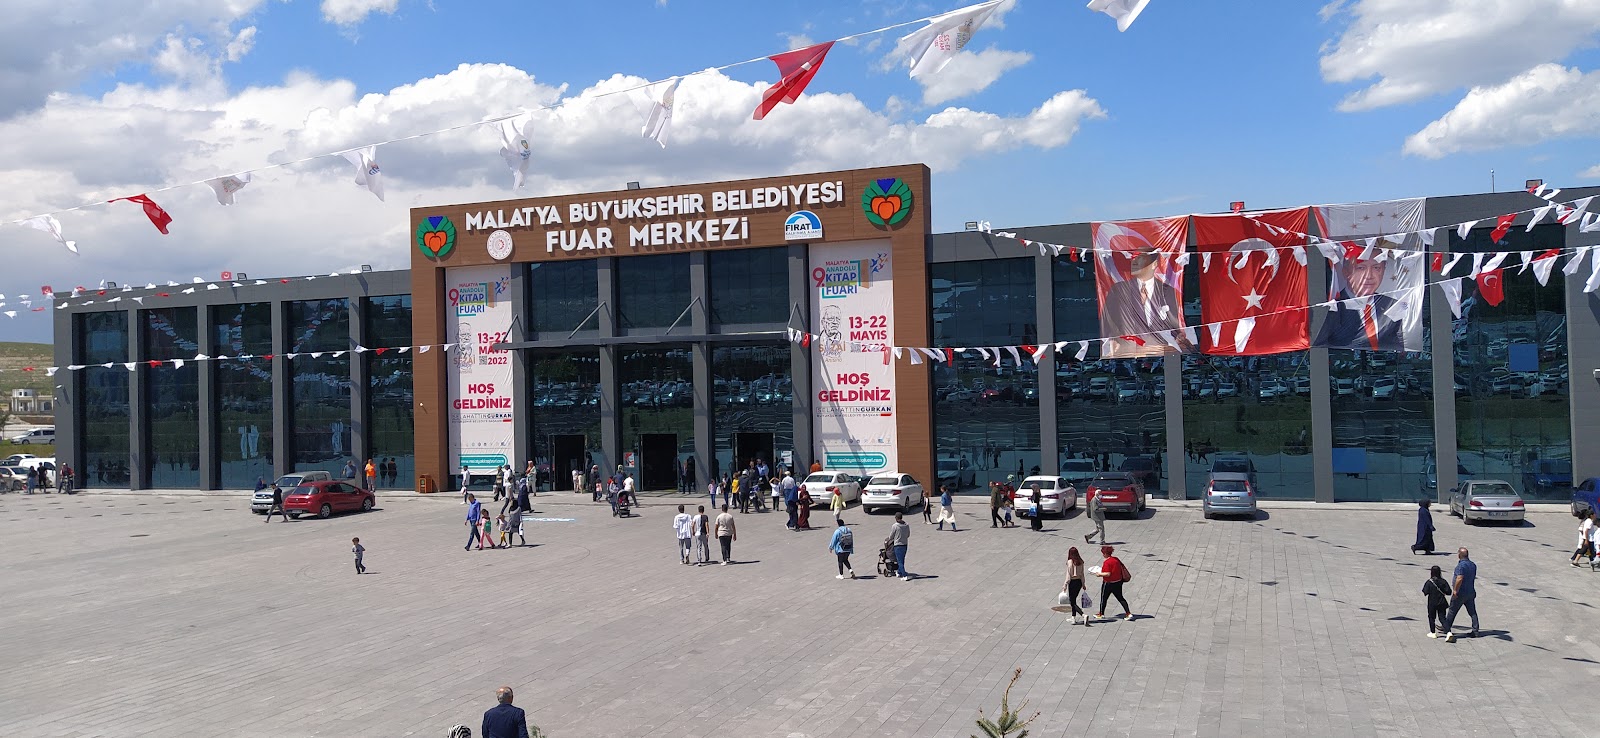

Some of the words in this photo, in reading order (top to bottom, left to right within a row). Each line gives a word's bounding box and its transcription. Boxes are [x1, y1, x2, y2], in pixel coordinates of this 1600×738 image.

[465, 205, 562, 231] MALATYA
[569, 193, 705, 224] BÜYÜKŞEHİR
[712, 181, 843, 212] BELEDİYESİ
[785, 223, 811, 231] FIRAT
[546, 227, 613, 252] FUAR
[629, 216, 749, 247] MERKEZİ
[825, 272, 857, 282] KİTAP
[826, 285, 857, 295] FUARI
[459, 293, 485, 302] KİTAP
[459, 304, 485, 314] FUARI
[848, 315, 887, 329] 13-22
[850, 330, 888, 341] MAYIS
[487, 356, 508, 365] 2022
[837, 372, 870, 387] HOŞ
[468, 383, 495, 395] HOŞ
[818, 387, 891, 402] GELDİNİZ
[453, 395, 511, 410] GELDİNİZ
